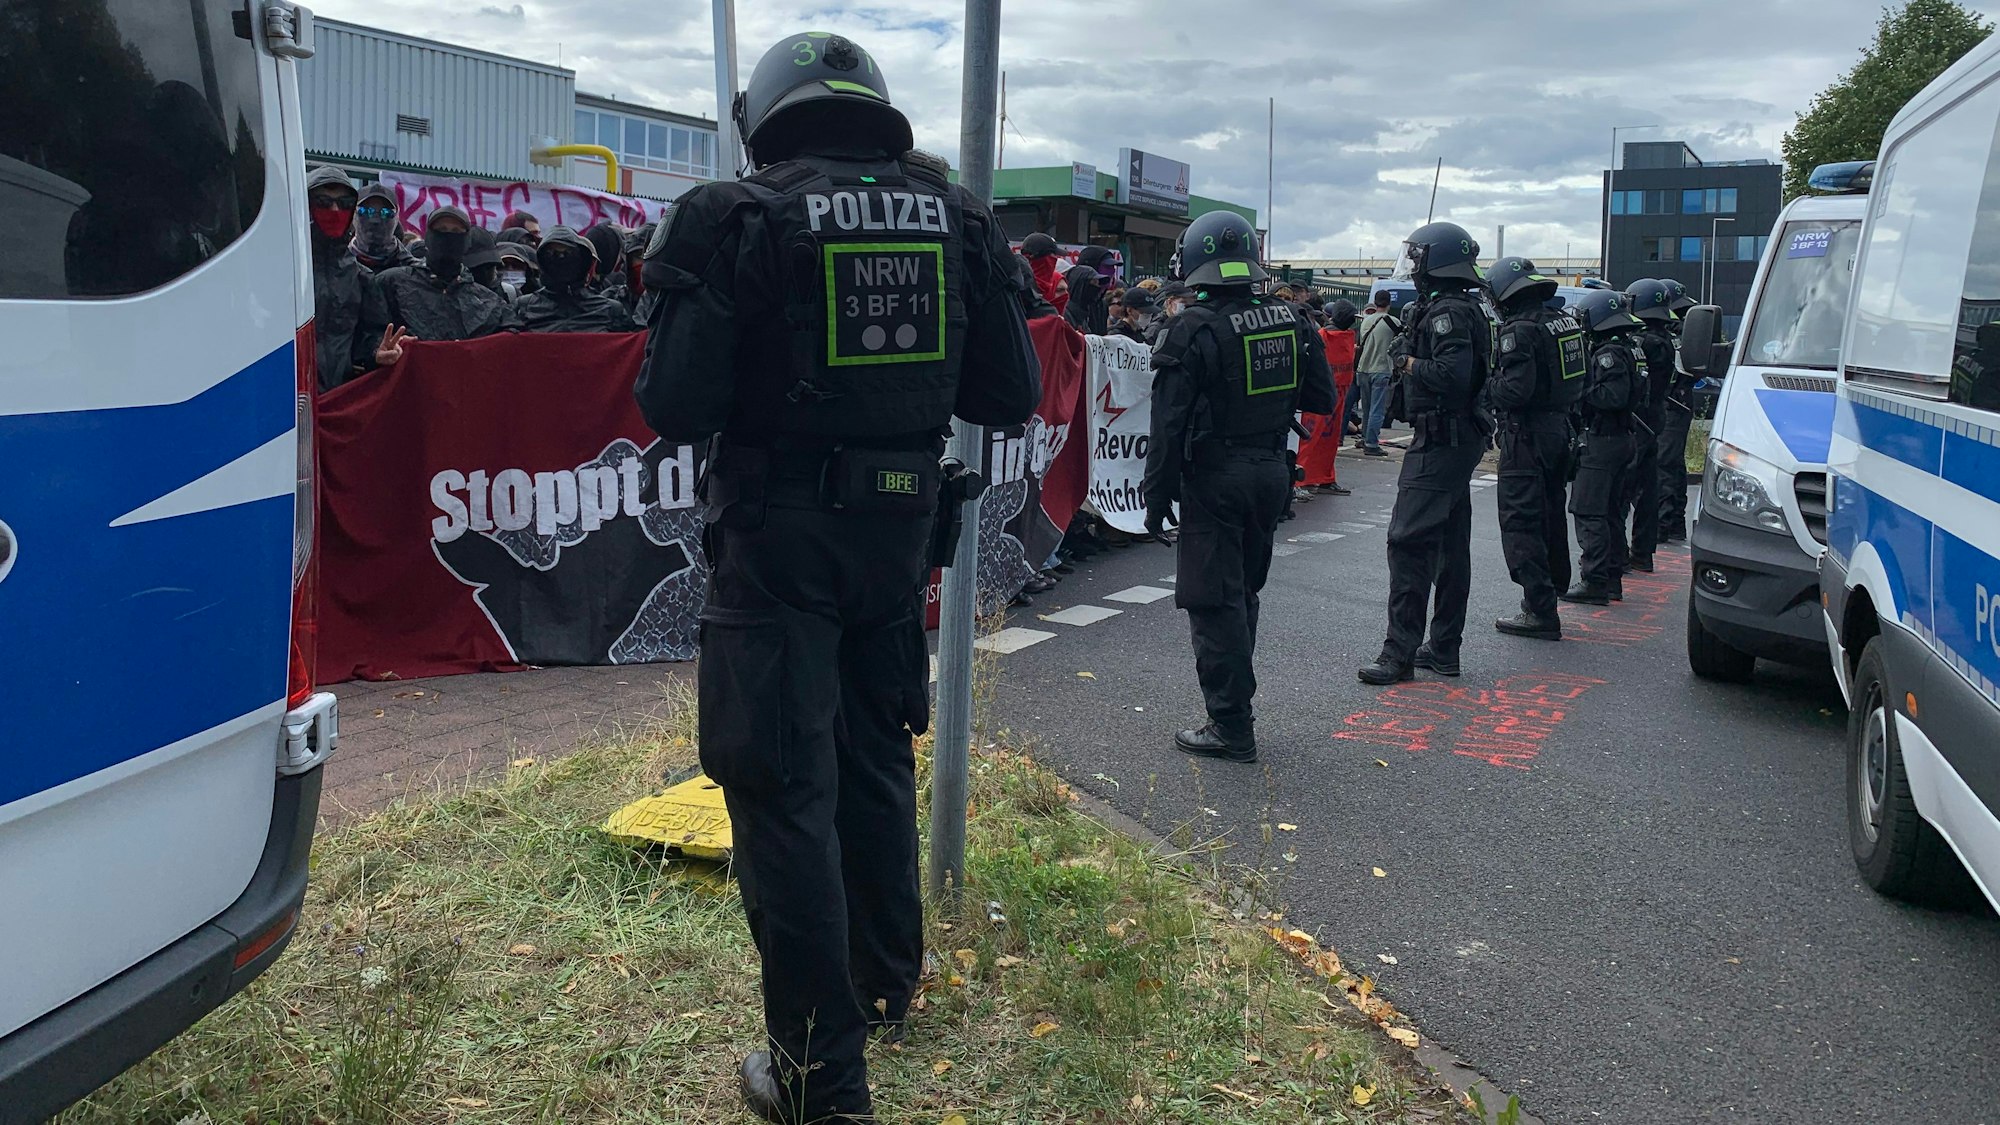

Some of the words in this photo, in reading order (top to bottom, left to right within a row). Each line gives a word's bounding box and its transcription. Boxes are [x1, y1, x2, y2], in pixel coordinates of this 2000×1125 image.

[792, 41, 816, 66] 3
[806, 191, 949, 233] POLIZEI
[1203, 235, 1216, 254] 3
[1242, 232, 1250, 250] 1
[1790, 242, 1797, 250] 3
[1798, 241, 1815, 249] BF
[1816, 240, 1828, 248] 13
[1794, 231, 1830, 241] NRW
[1460, 239, 1469, 255] 3
[854, 256, 920, 286] NRW
[1509, 261, 1521, 271] 3
[845, 295, 860, 318] 3
[868, 294, 900, 317] BF
[908, 293, 930, 315] 11
[1608, 299, 1618, 310] 3
[1655, 292, 1663, 303] 3
[1229, 305, 1296, 333] POLIZEI
[1257, 338, 1286, 356] NRW
[1565, 339, 1579, 352] NRW
[1254, 359, 1261, 371] 3
[1264, 357, 1279, 370] BF
[1281, 355, 1290, 367] 11
[430, 456, 647, 543] Stoppt
[658, 445, 706, 509] d
[991, 431, 1026, 486] in
[885, 473, 912, 491] BFE
